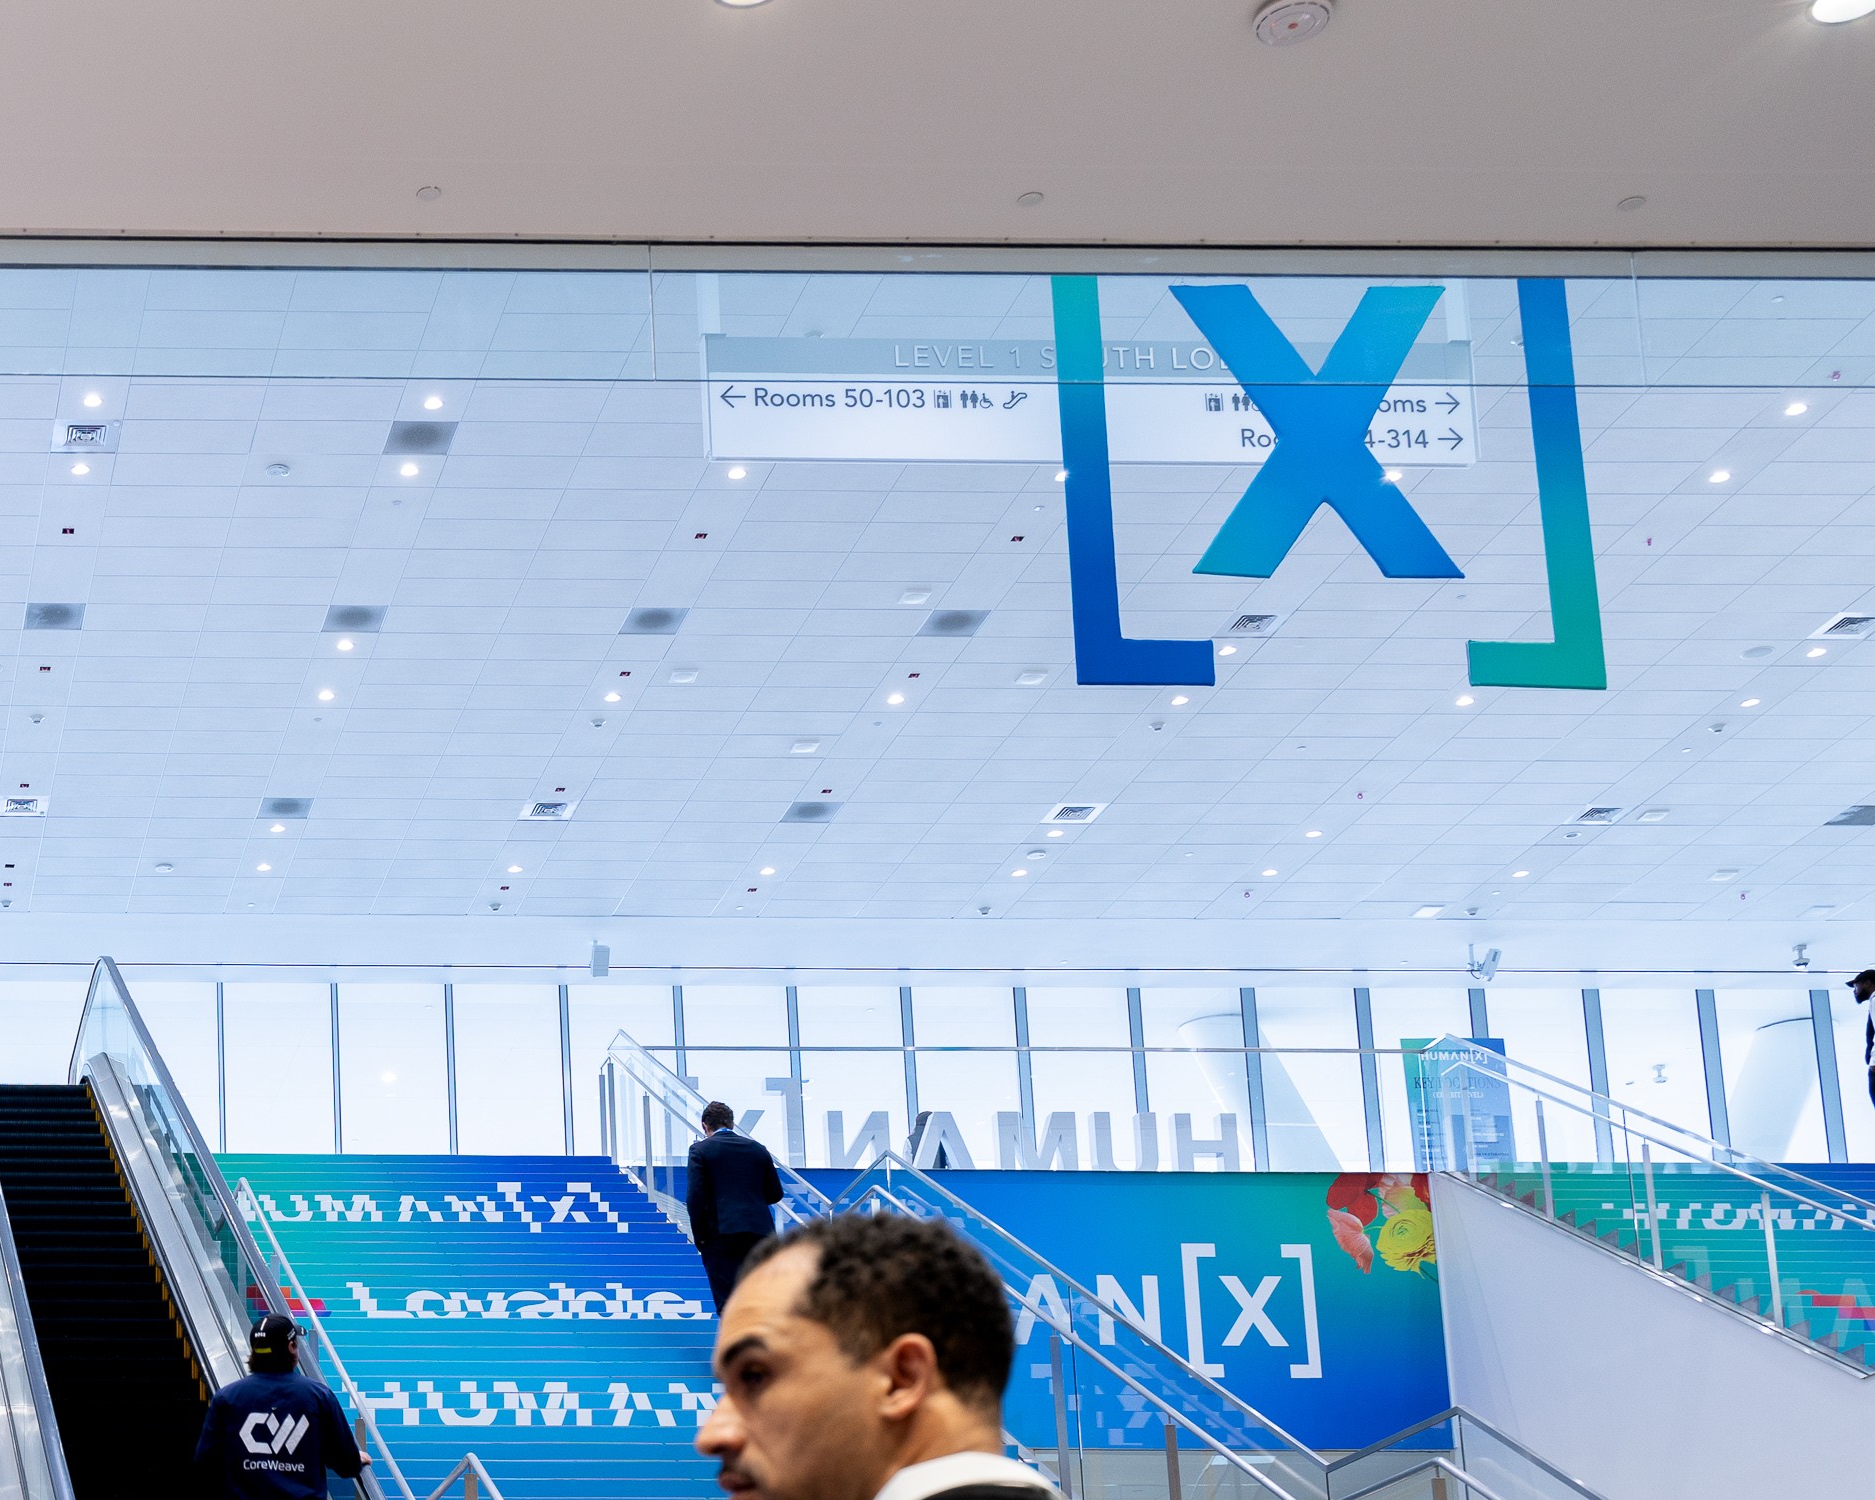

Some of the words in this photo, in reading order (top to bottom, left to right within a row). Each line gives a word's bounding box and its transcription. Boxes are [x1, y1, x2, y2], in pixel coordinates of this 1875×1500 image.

[893, 345, 994, 369] LEVEL
[1009, 347, 1021, 368] 1
[1039, 346, 1155, 369] STH
[753, 387, 836, 408] Rooms
[844, 388, 926, 409] 50-103
[345, 1281, 713, 1320] Lovable
[242, 1458, 305, 1473] CoreWeave
